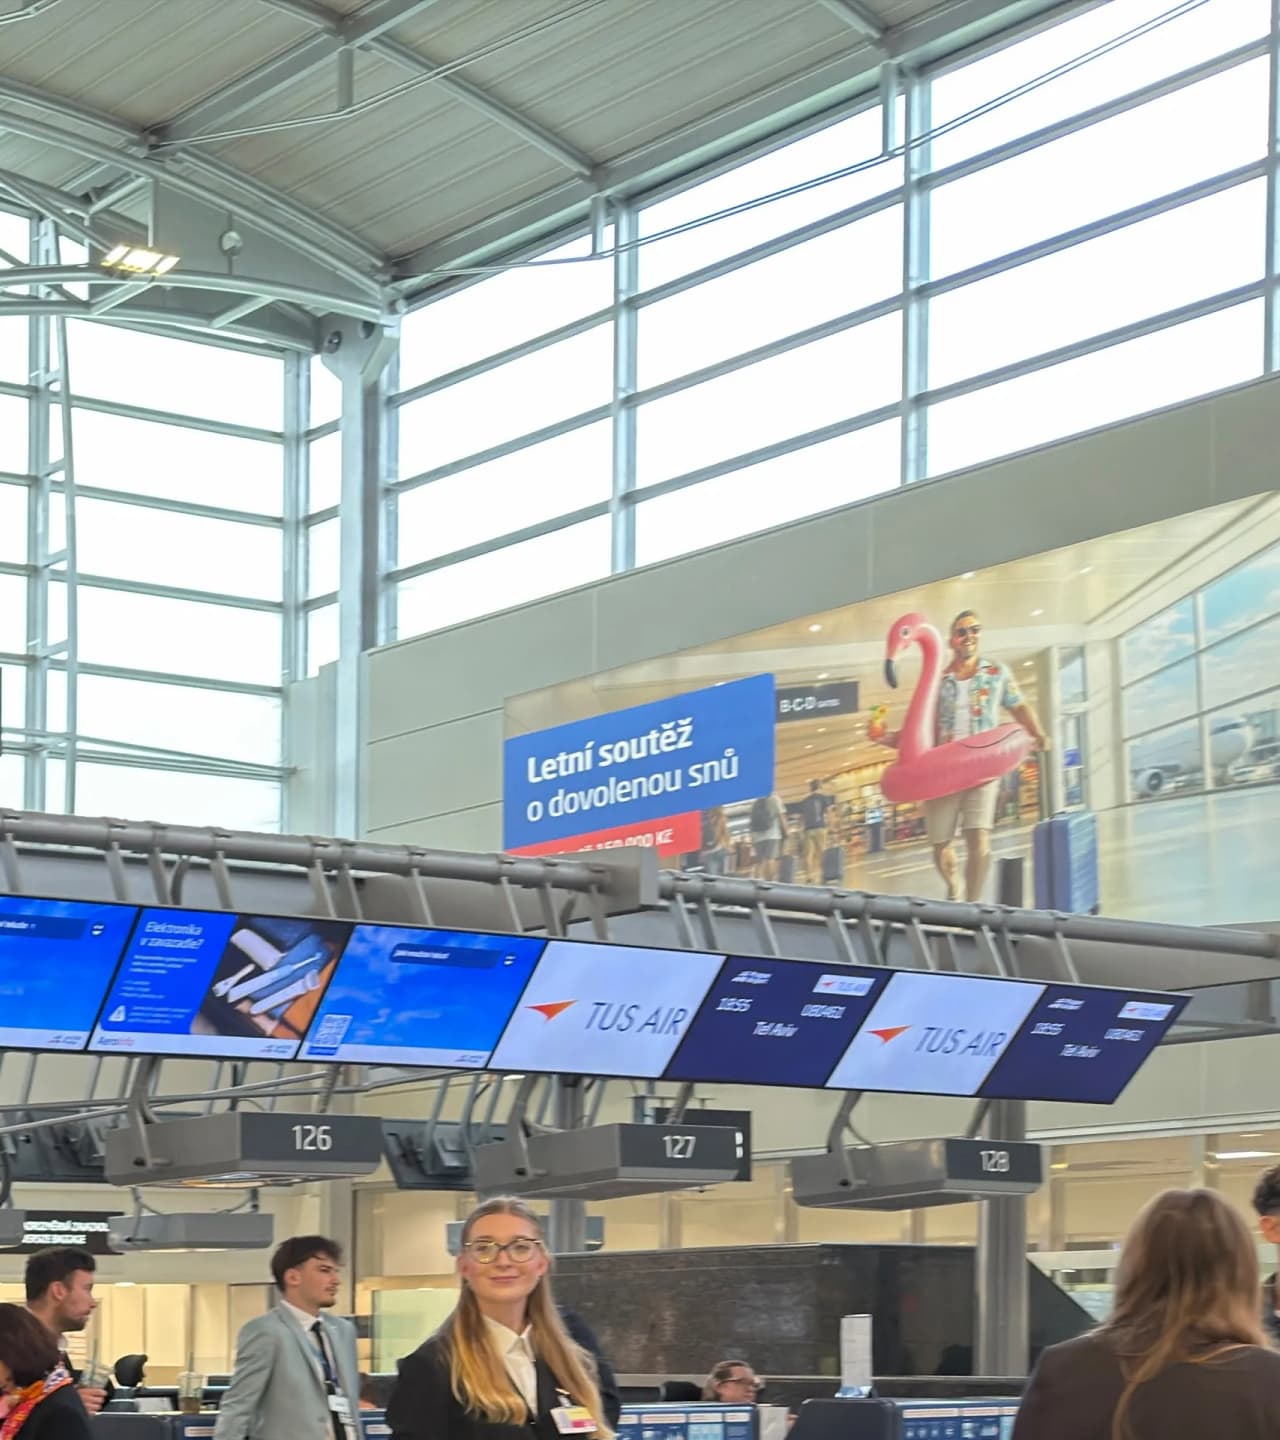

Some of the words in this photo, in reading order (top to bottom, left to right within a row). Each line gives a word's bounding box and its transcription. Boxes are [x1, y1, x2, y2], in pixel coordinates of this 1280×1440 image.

[527, 740, 595, 784] Letní
[598, 716, 693, 767] soutěž
[526, 802, 542, 823] o
[548, 771, 681, 818] dovolenou
[688, 747, 738, 786] snů
[584, 1002, 636, 1031] TUS
[637, 1007, 689, 1036] AIR
[914, 1026, 961, 1053] TUS
[960, 1031, 1008, 1056] AIR
[291, 1124, 332, 1151] 126
[662, 1135, 697, 1159] 127
[980, 1150, 1010, 1172] 128
